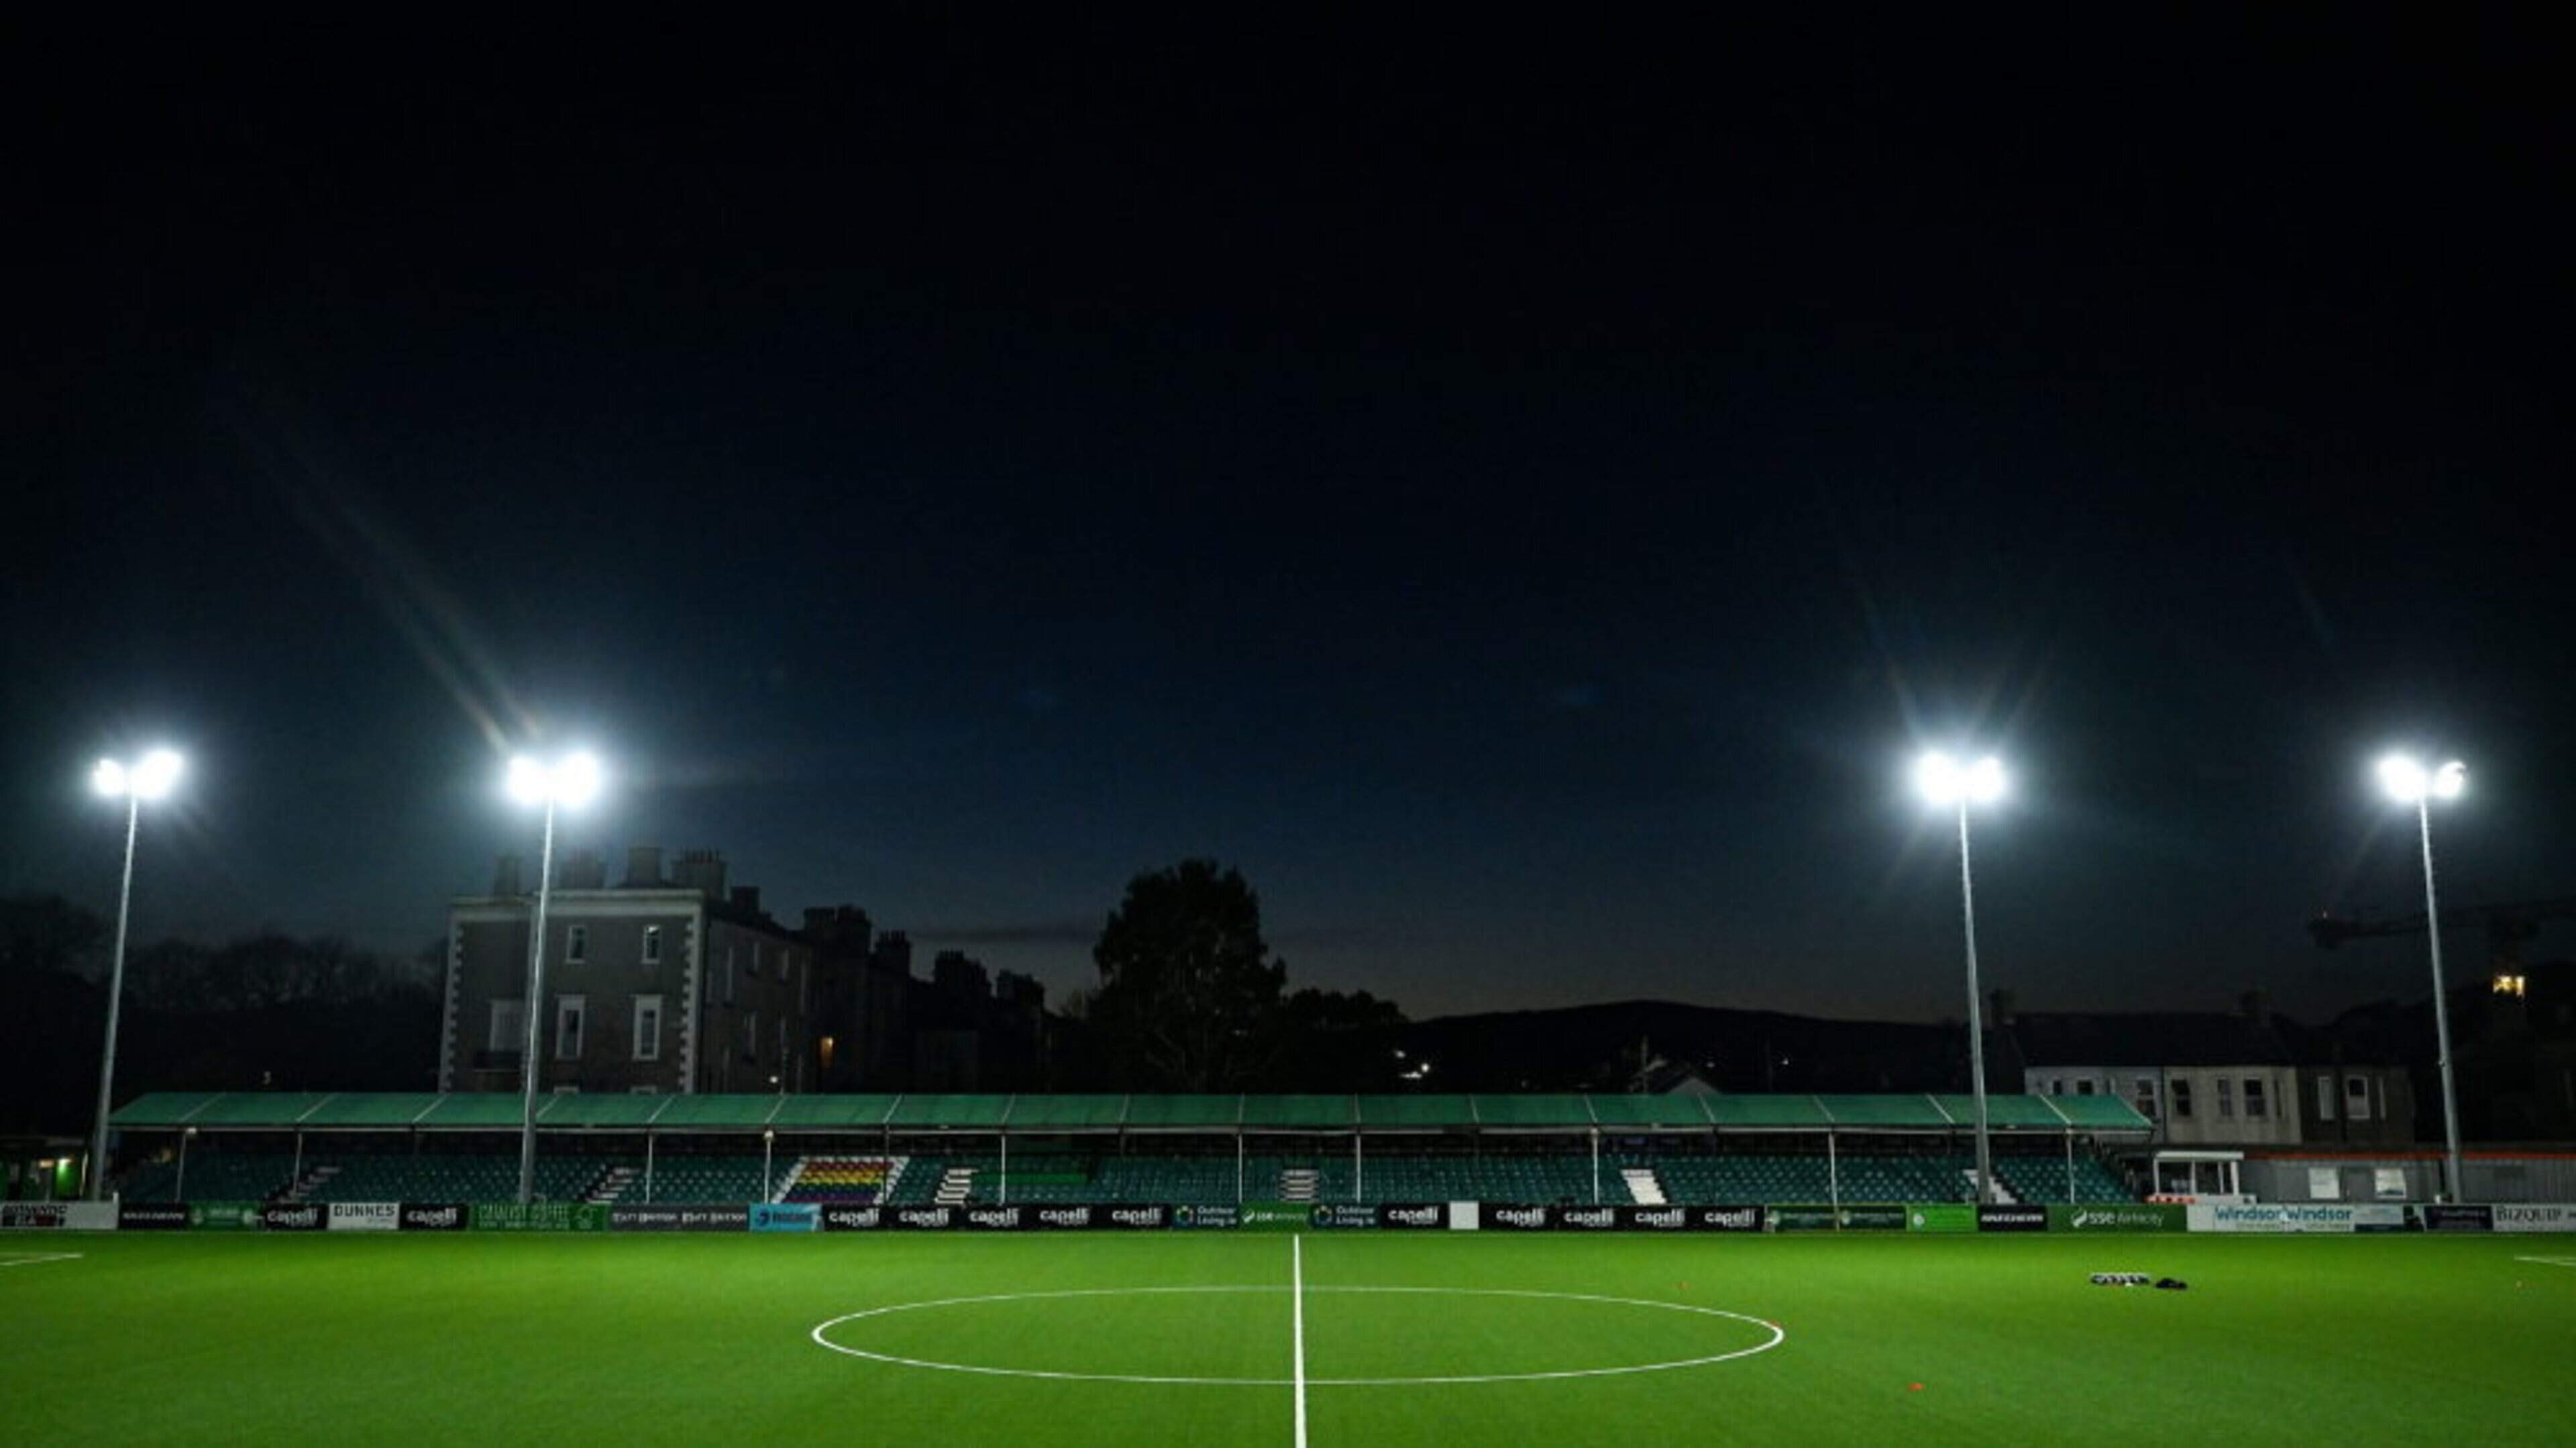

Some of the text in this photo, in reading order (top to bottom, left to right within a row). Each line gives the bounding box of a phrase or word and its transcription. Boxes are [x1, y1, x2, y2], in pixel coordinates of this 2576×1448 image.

[334, 1204, 394, 1217] DUNNES
[828, 1208, 879, 1224] capelli
[899, 1208, 949, 1225] capelli
[969, 1208, 1019, 1225] capelli
[1040, 1208, 1090, 1224] capelli
[1112, 1208, 1162, 1224] capelli
[1388, 1208, 1439, 1223] capelli
[1496, 1208, 1545, 1224] capelli
[1564, 1208, 1613, 1225] capelli
[1635, 1209, 1685, 1225] capelli
[1705, 1209, 1755, 1225] capelli
